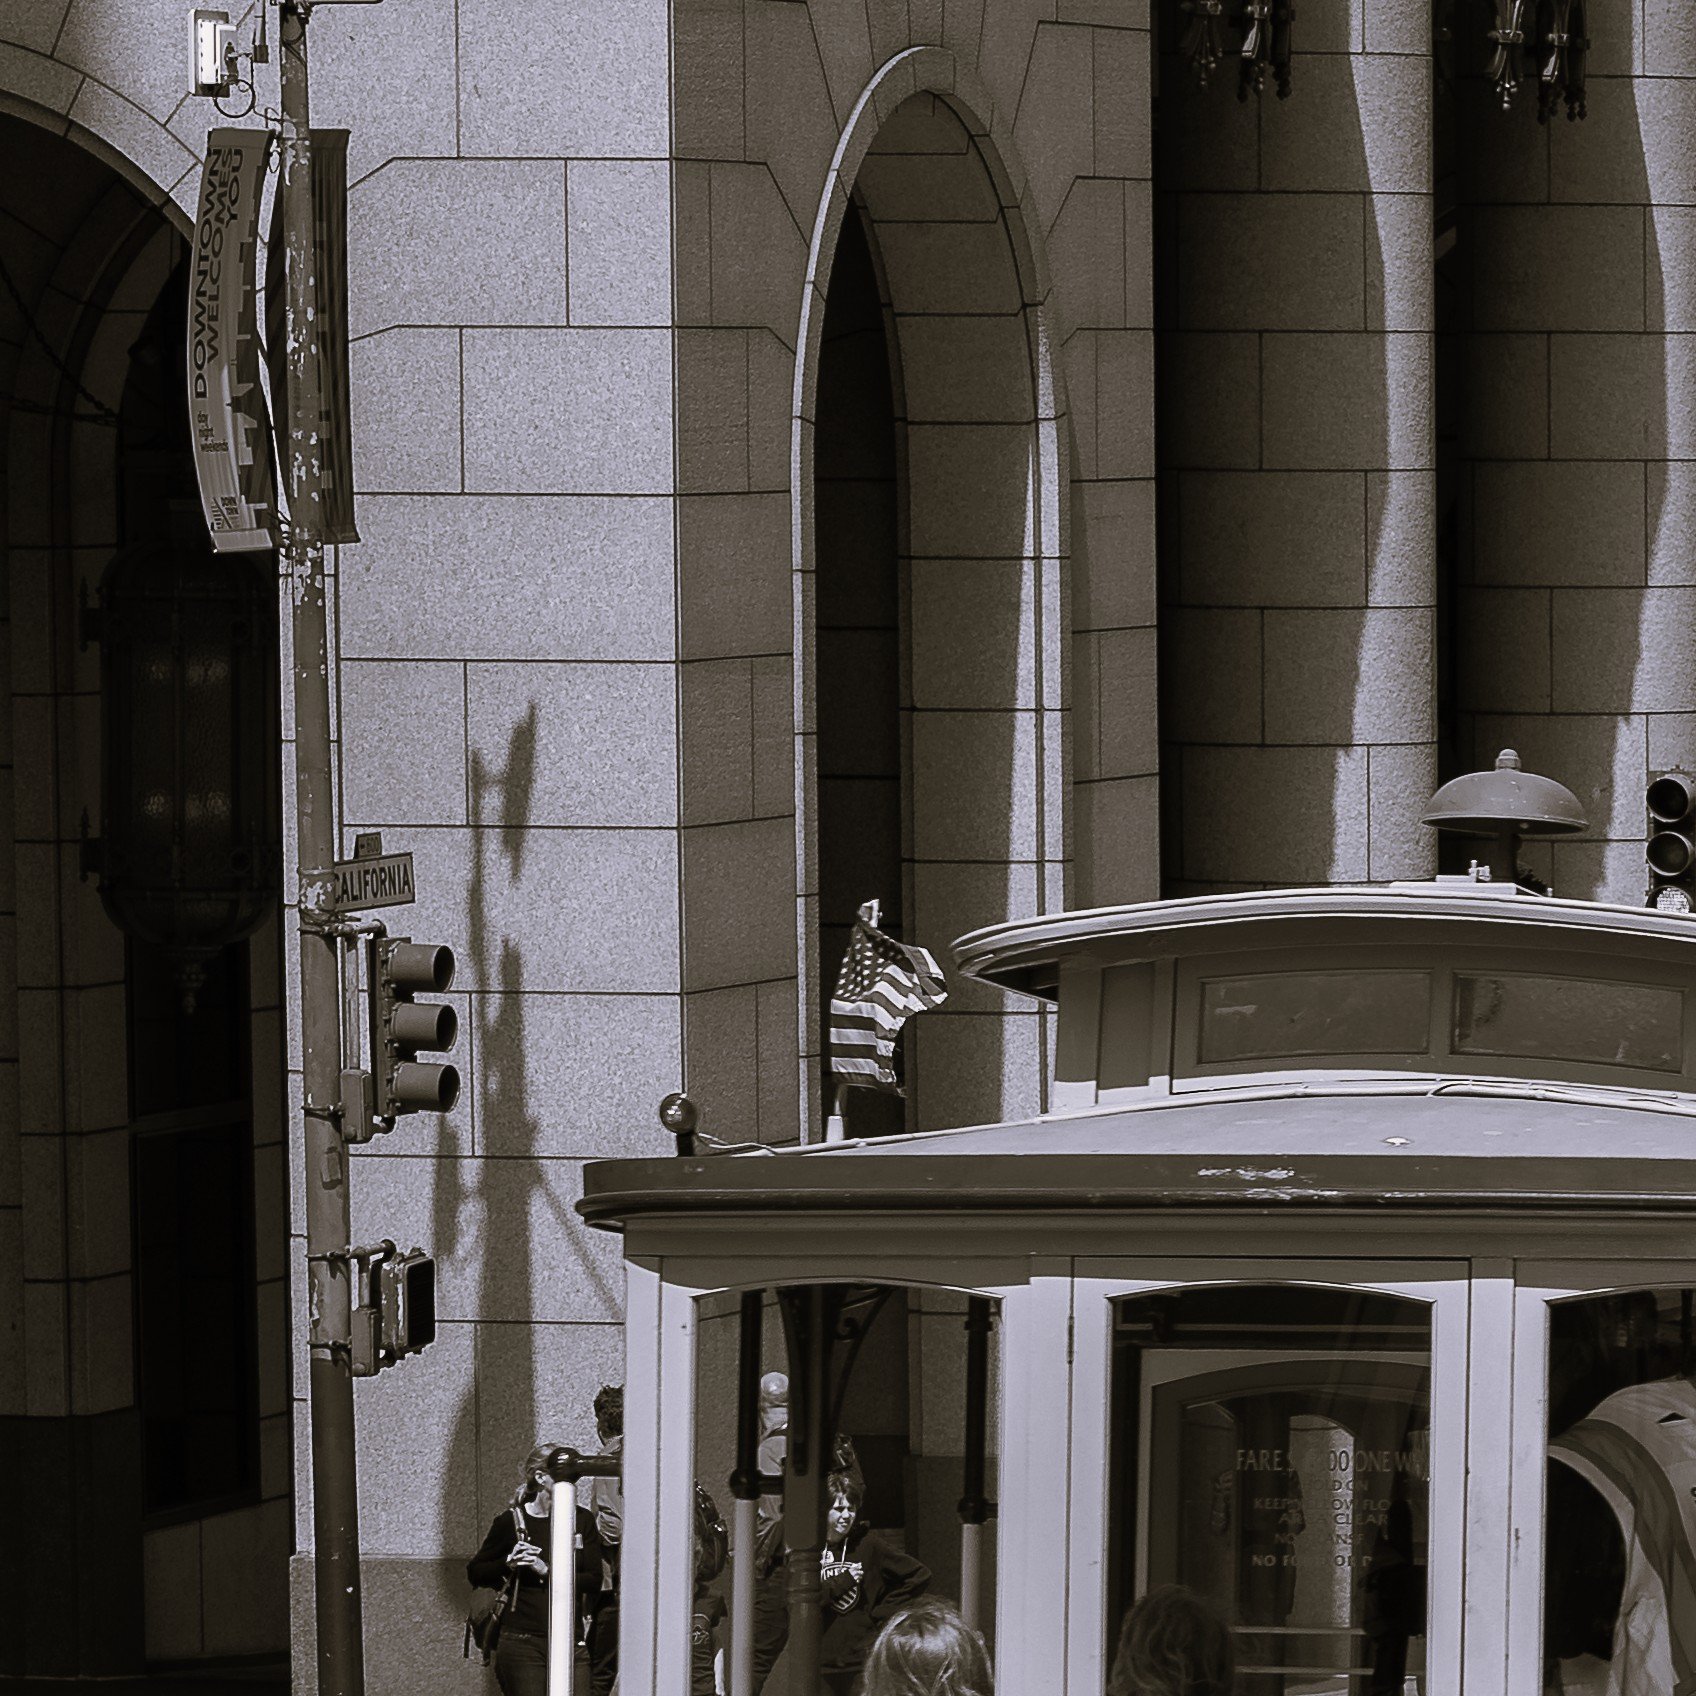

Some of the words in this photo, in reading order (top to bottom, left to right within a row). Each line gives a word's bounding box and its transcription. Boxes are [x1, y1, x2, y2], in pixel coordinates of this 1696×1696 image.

[224, 148, 244, 229] YOU
[193, 148, 223, 399] DOWNTOWN
[206, 148, 235, 363] WELCOMES
[335, 863, 411, 904] CALIFORNIA
[1235, 1449, 1283, 1471] FARE
